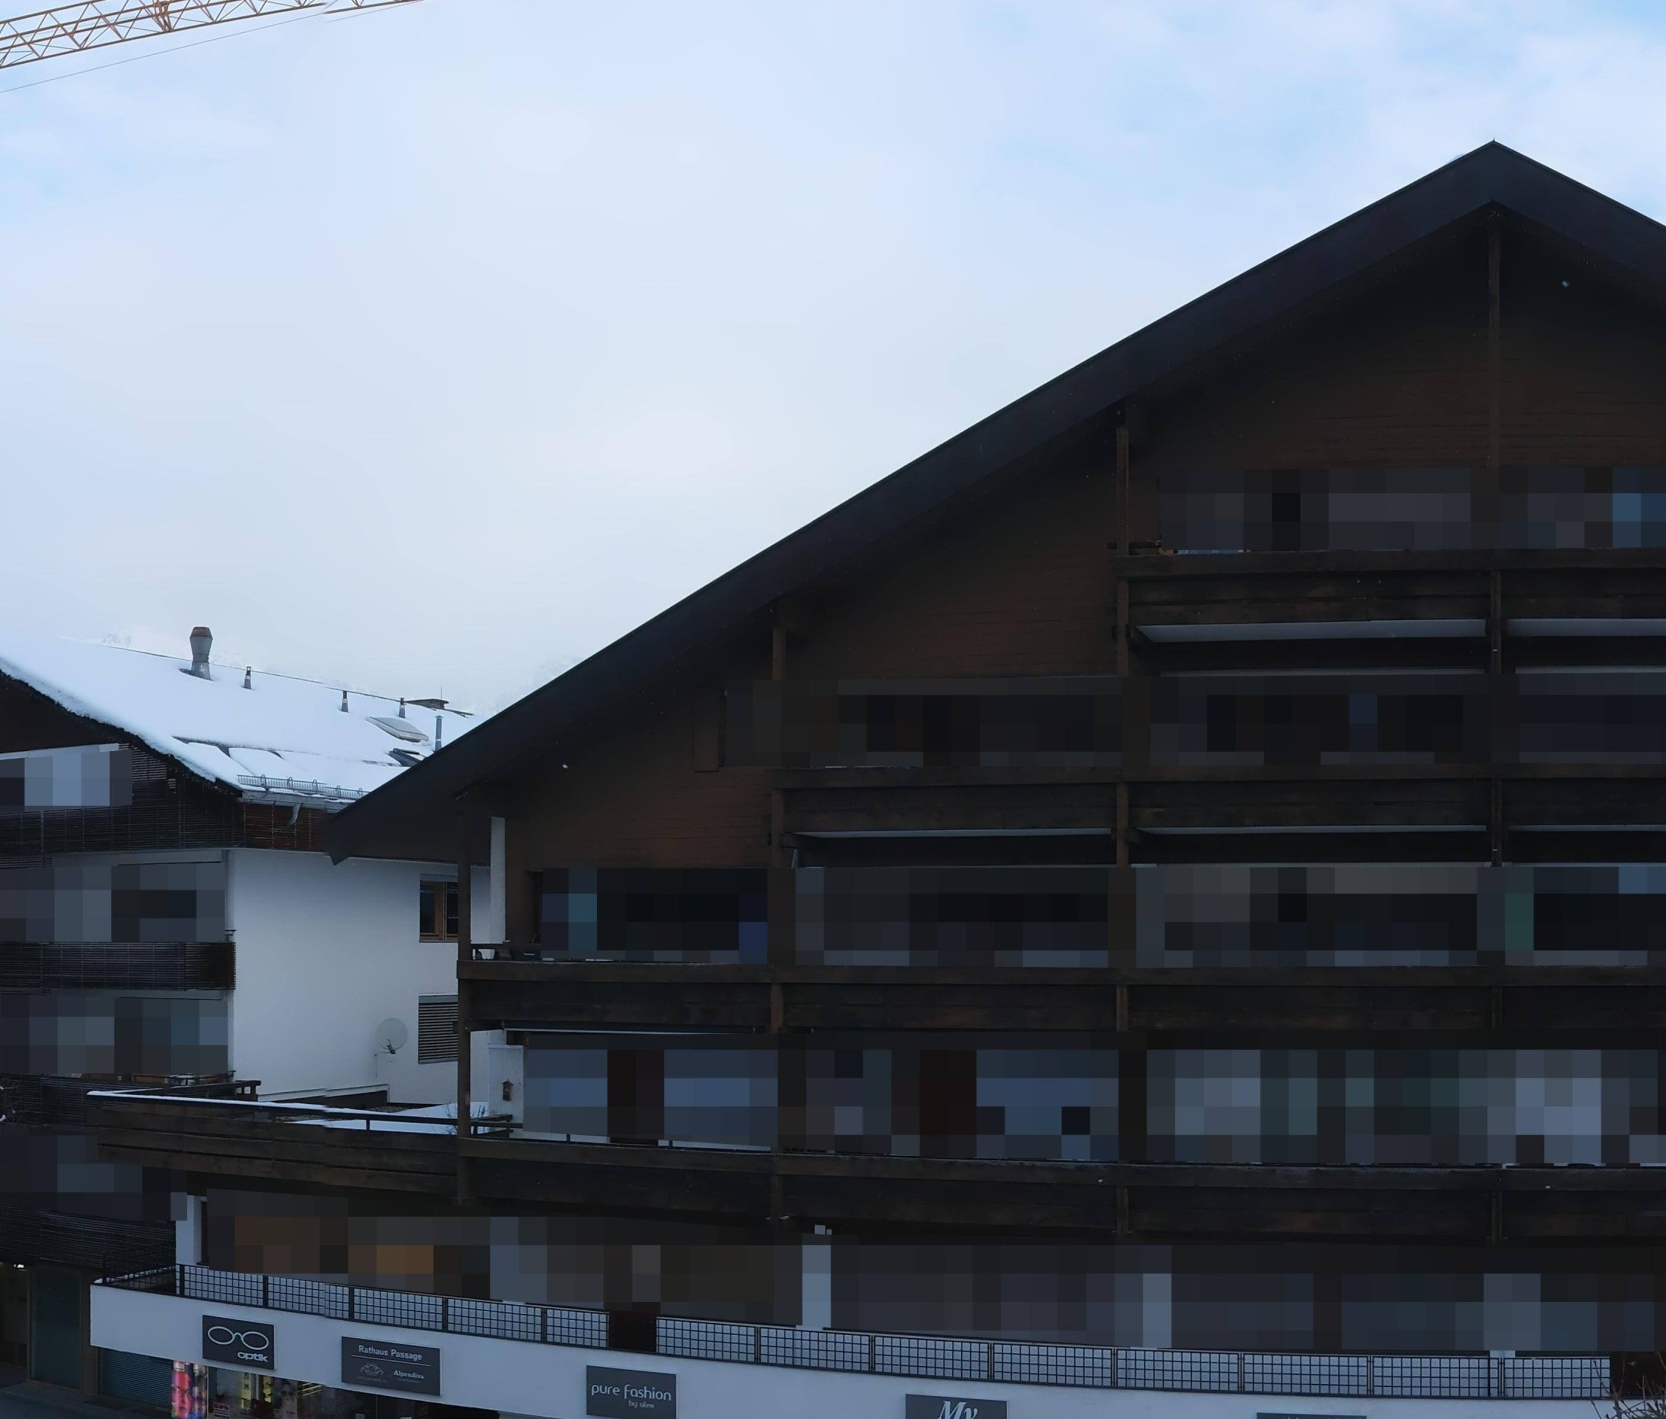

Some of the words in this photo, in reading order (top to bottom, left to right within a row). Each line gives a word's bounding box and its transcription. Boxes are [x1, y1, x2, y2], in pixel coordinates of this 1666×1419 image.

[237, 1351, 269, 1363] optik
[358, 1345, 389, 1357] Rathaus
[390, 1348, 423, 1362] Passage
[591, 1384, 620, 1396] pure
[623, 1384, 672, 1402] fashion
[628, 1400, 638, 1409] by
